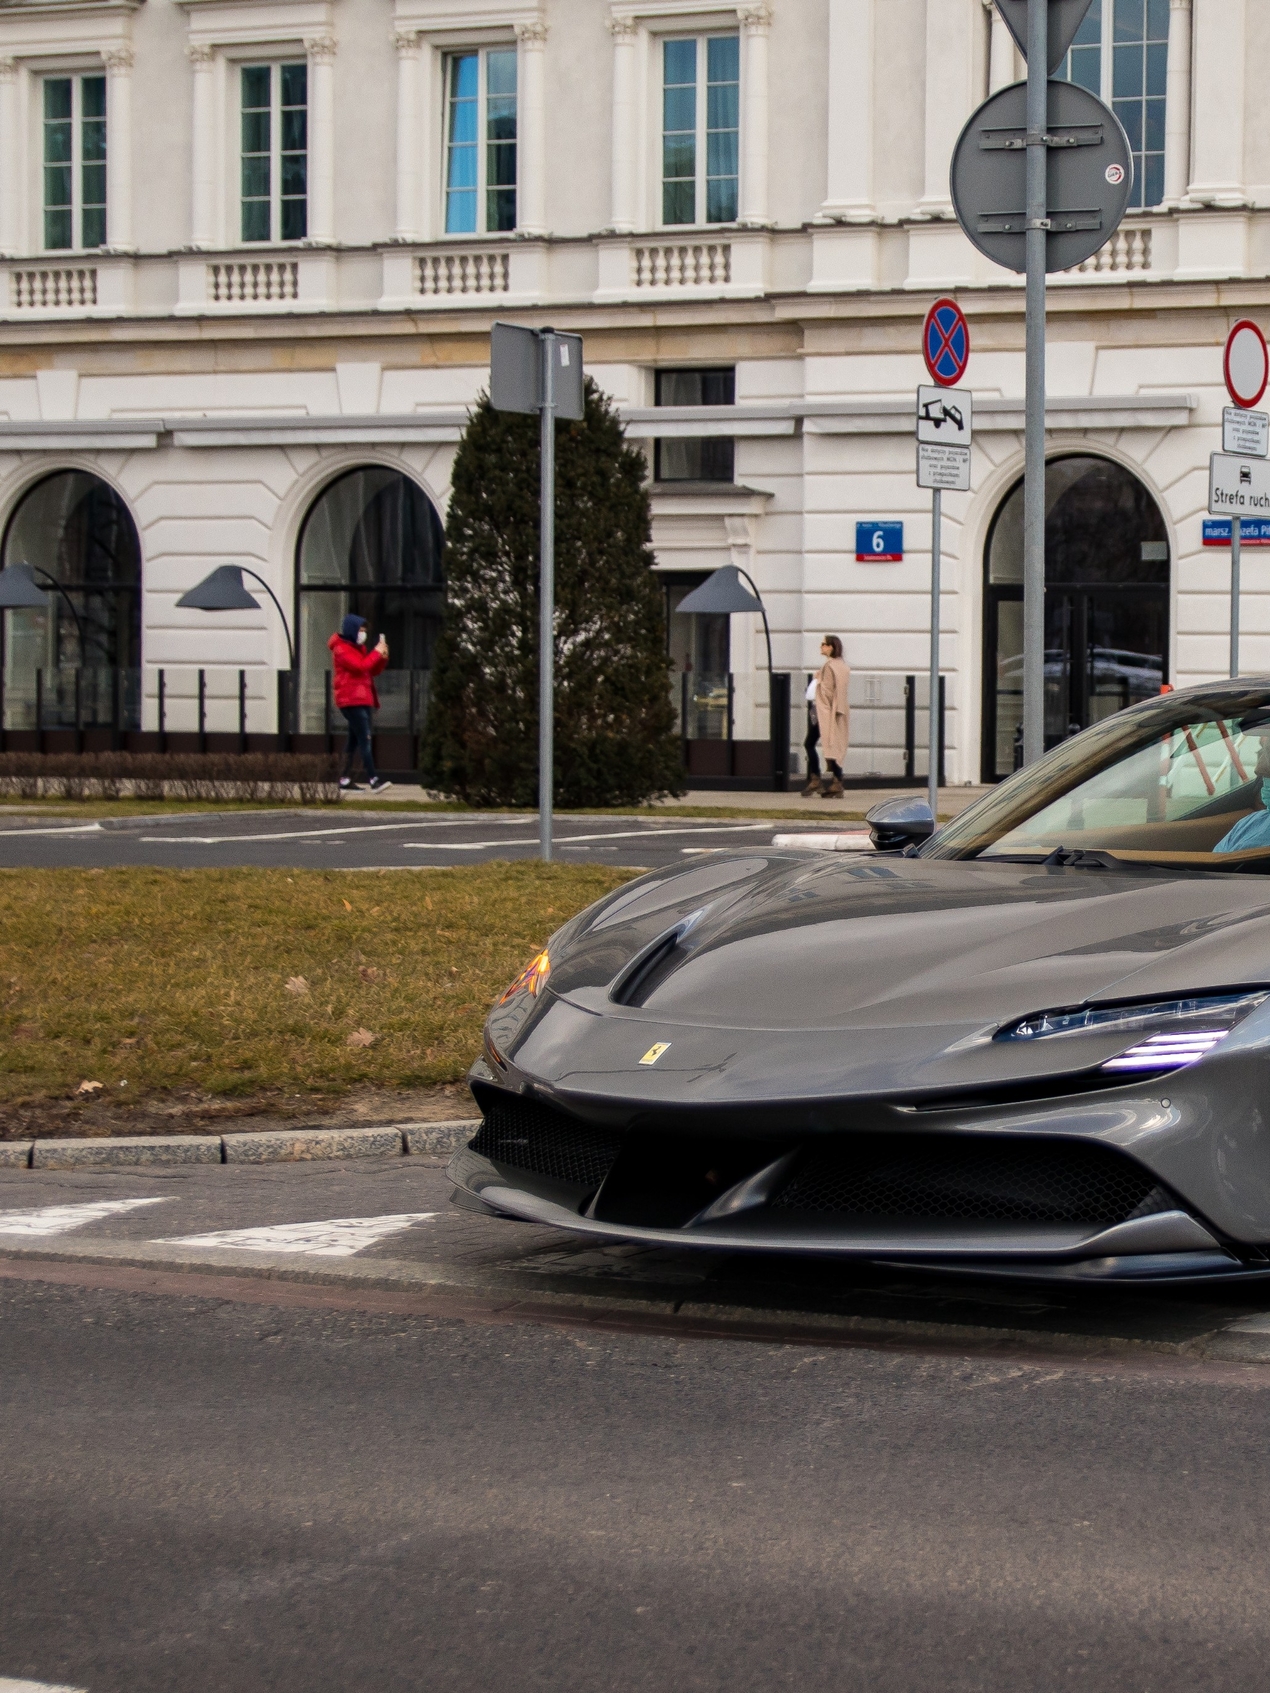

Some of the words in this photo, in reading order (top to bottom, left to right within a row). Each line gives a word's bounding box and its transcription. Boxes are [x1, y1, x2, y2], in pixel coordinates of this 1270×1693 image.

[1214, 487, 1245, 505] Strefa
[1205, 527, 1232, 536] marsz.
[1240, 525, 1259, 536] zefa
[872, 530, 884, 552] 6
